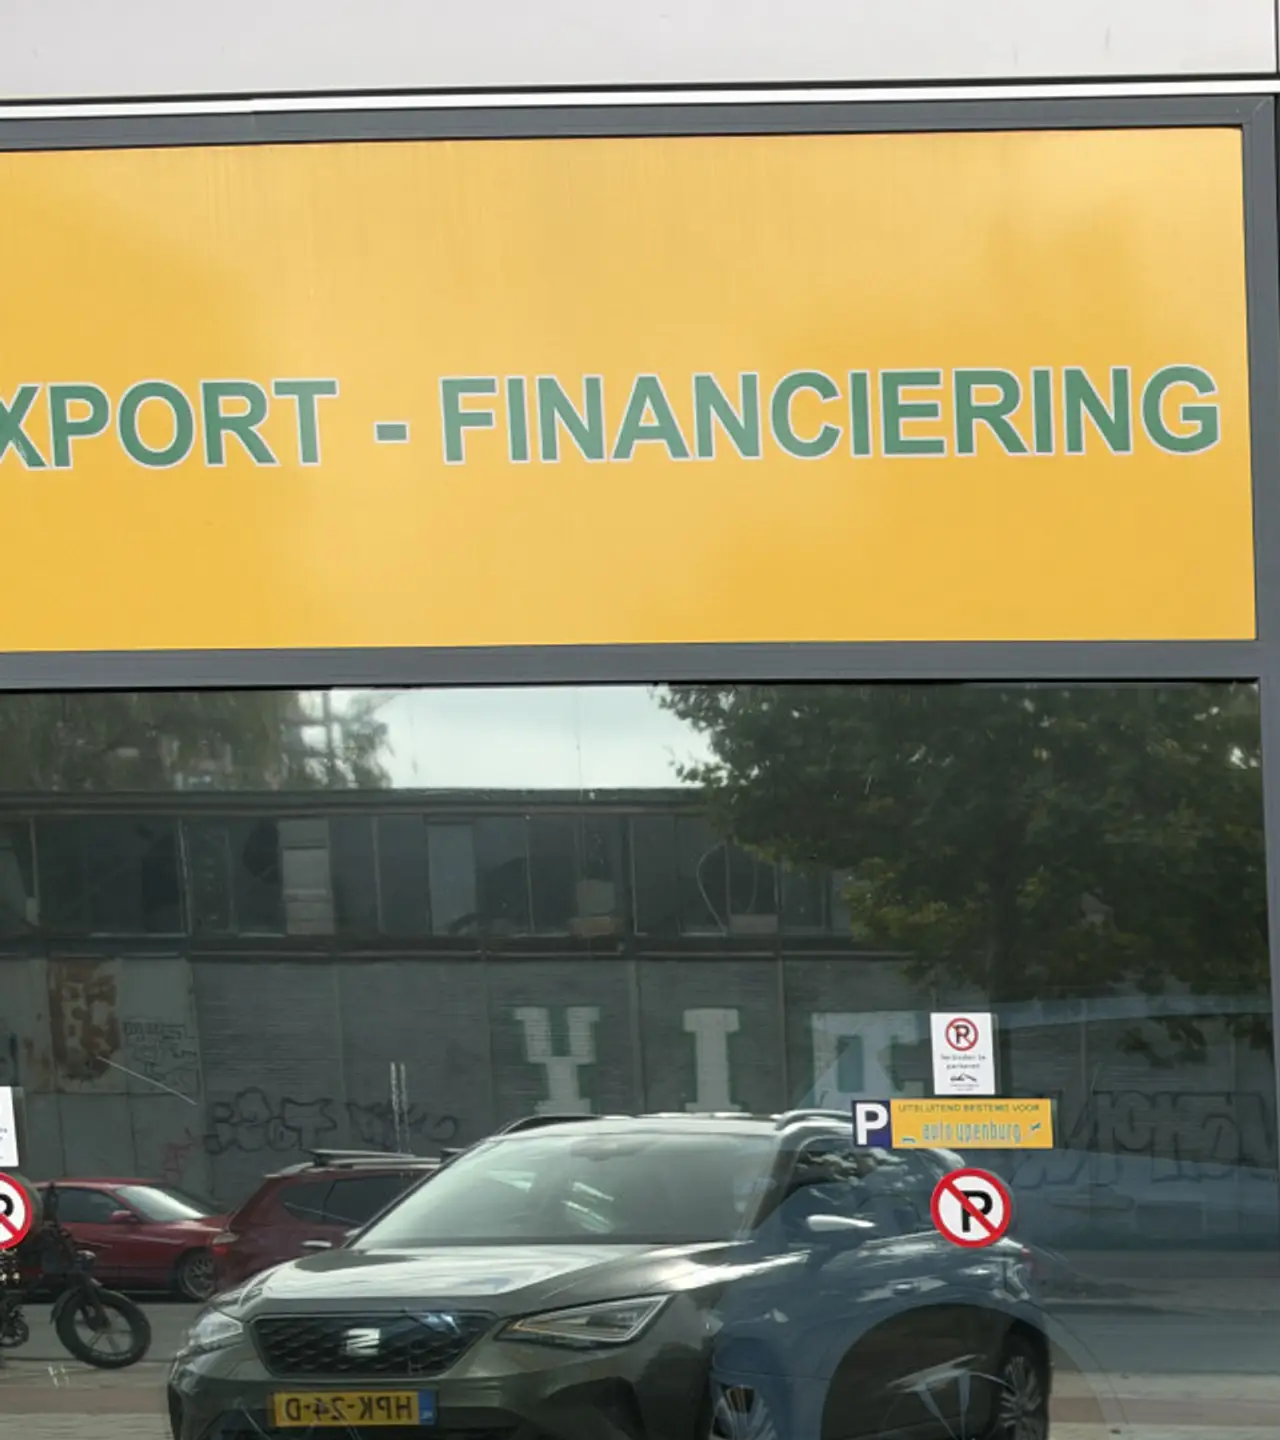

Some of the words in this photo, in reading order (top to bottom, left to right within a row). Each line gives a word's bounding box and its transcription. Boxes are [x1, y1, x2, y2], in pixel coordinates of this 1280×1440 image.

[0, 380, 338, 470] XPORT
[374, 418, 409, 444] -
[439, 362, 1222, 464] FINANCIERING
[855, 1102, 889, 1146] P
[1012, 1103, 1040, 1112] VOOR
